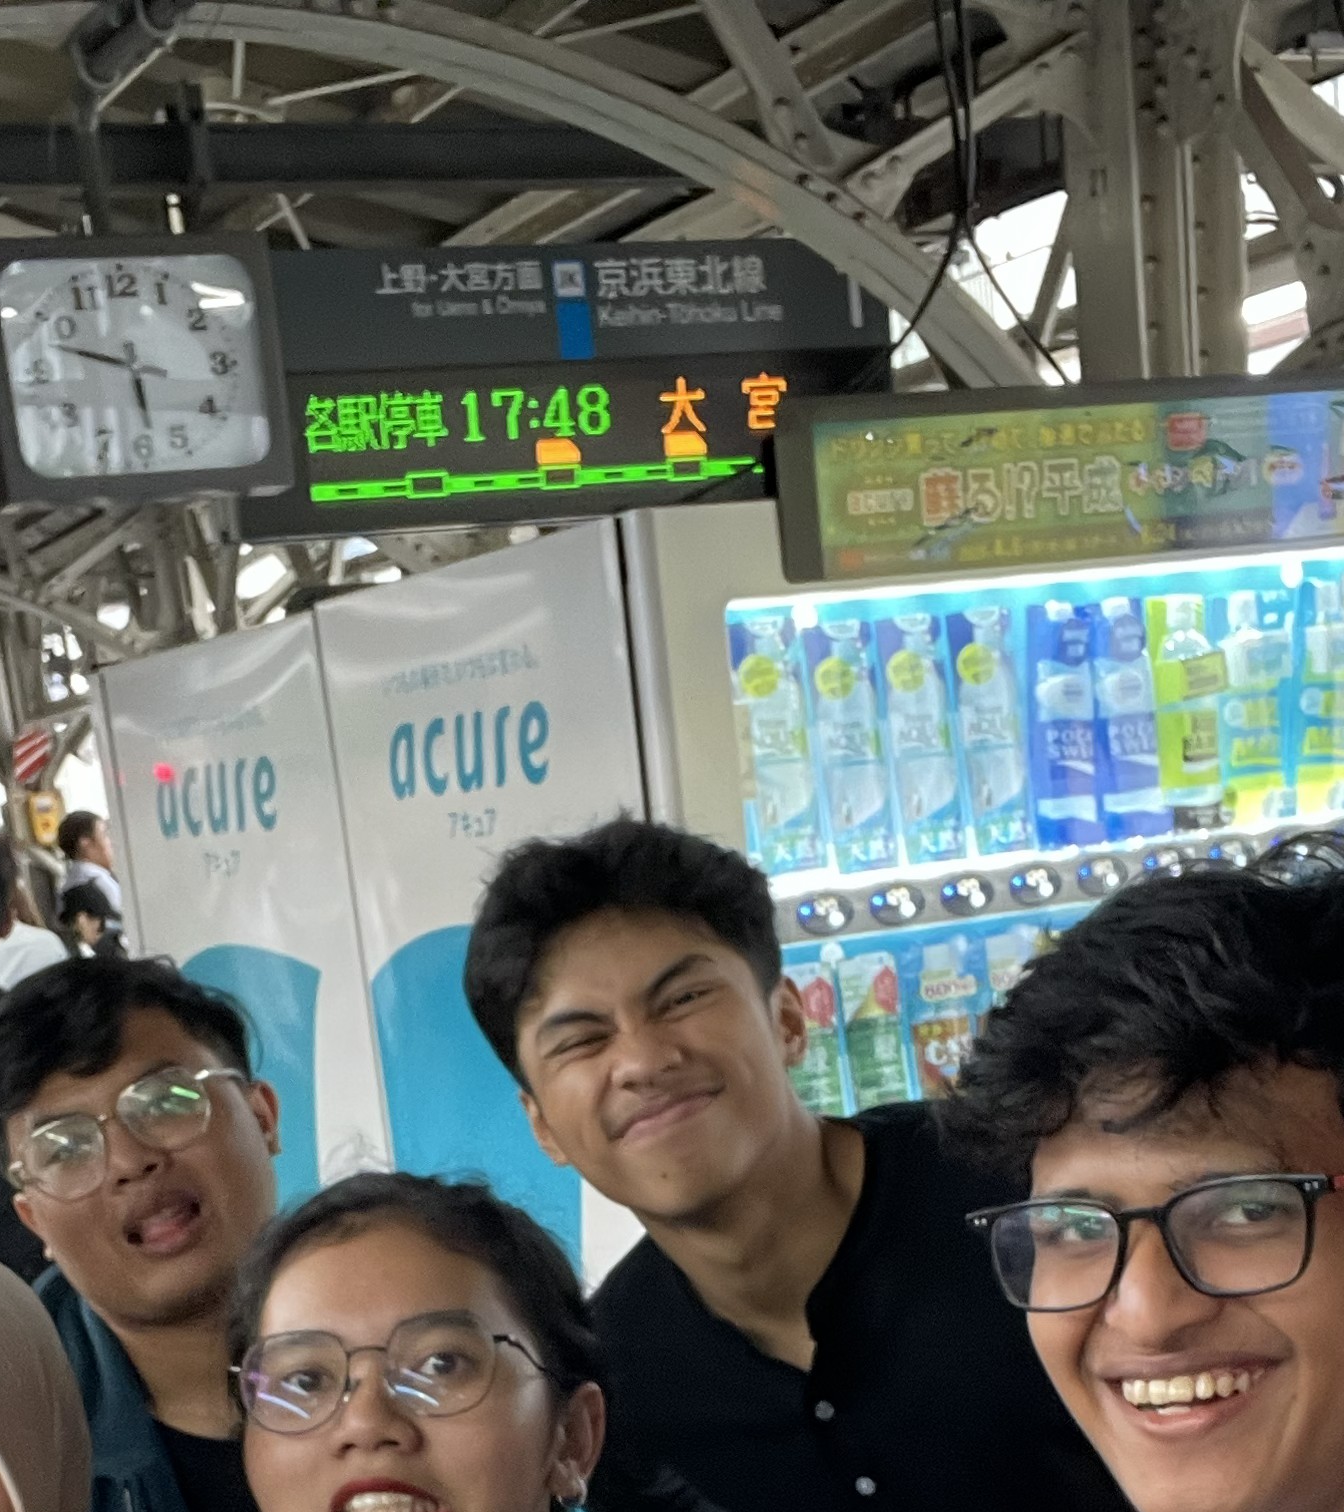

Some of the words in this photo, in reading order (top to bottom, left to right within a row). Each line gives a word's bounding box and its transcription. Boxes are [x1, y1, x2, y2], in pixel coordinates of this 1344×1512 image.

[107, 272, 139, 299] 12
[593, 255, 768, 298] 京浜東北線
[305, 390, 448, 453] 各駅停車
[460, 384, 611, 442] 17:48
[388, 699, 551, 801] acure
[156, 756, 278, 839] acure
